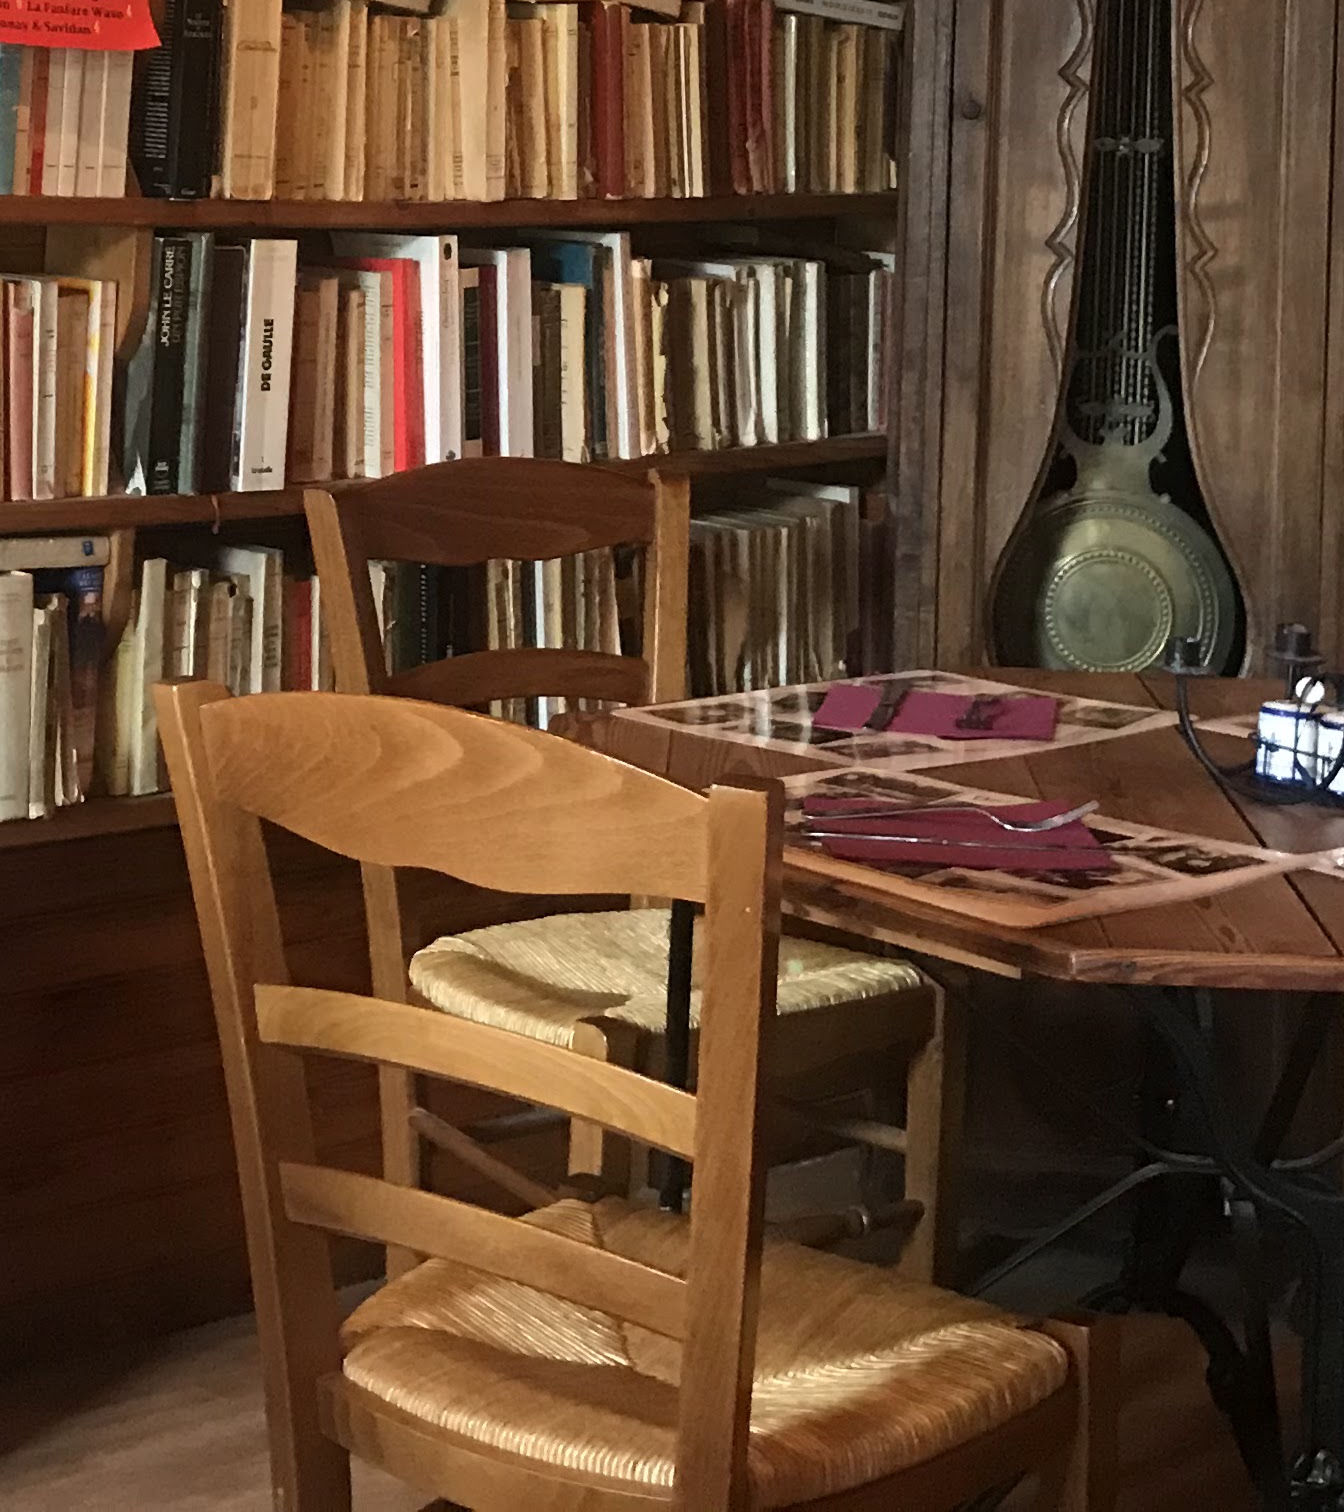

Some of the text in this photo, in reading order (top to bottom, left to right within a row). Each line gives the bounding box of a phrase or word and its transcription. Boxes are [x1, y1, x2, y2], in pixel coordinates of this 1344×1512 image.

[160, 291, 172, 347] JOHN LE
[260, 318, 274, 391] DE GAULLE
